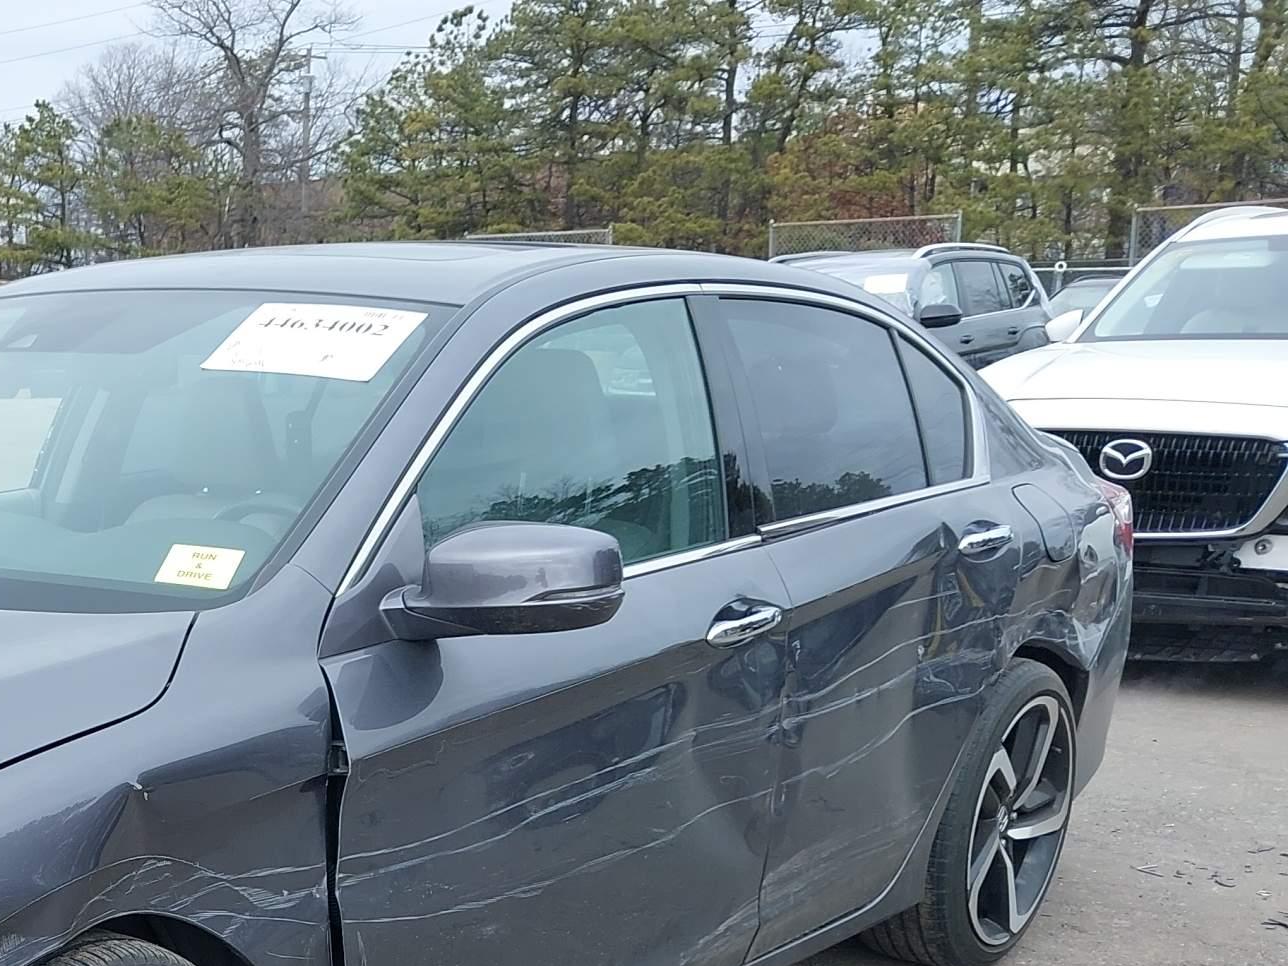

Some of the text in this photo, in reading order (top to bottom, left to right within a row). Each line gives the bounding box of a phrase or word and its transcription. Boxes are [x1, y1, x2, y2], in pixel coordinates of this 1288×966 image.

[257, 316, 390, 336] 44634002
[192, 552, 217, 561] RUN
[176, 570, 213, 581] DRIVE
